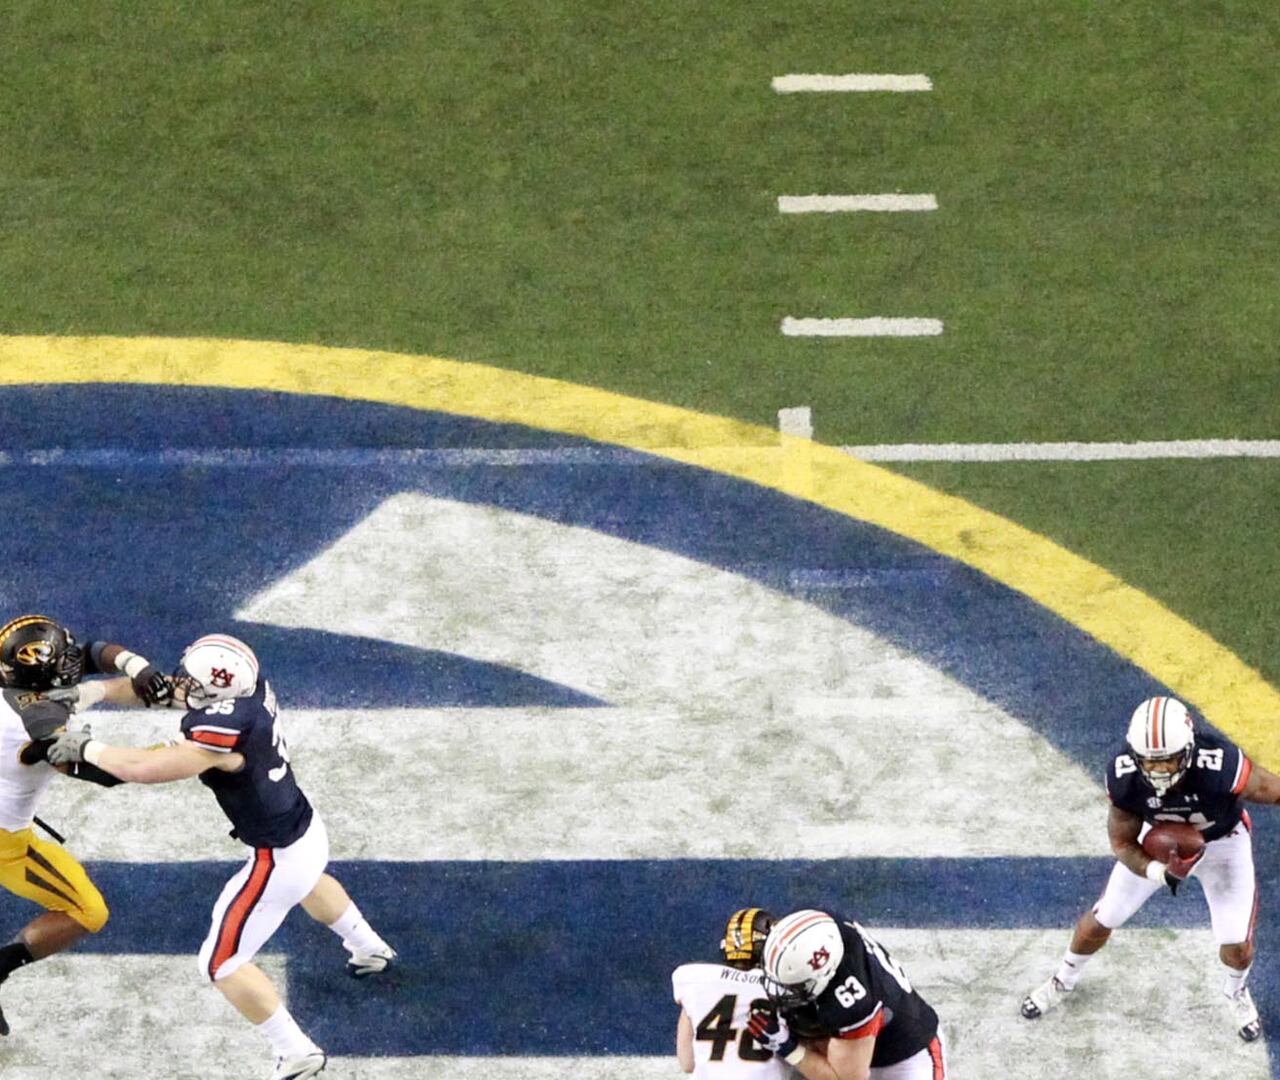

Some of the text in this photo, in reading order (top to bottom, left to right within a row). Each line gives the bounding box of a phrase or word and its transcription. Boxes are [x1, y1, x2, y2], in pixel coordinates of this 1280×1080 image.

[1115, 754, 1137, 778] 21
[1197, 748, 1224, 771] 21
[834, 975, 867, 1009] 63
